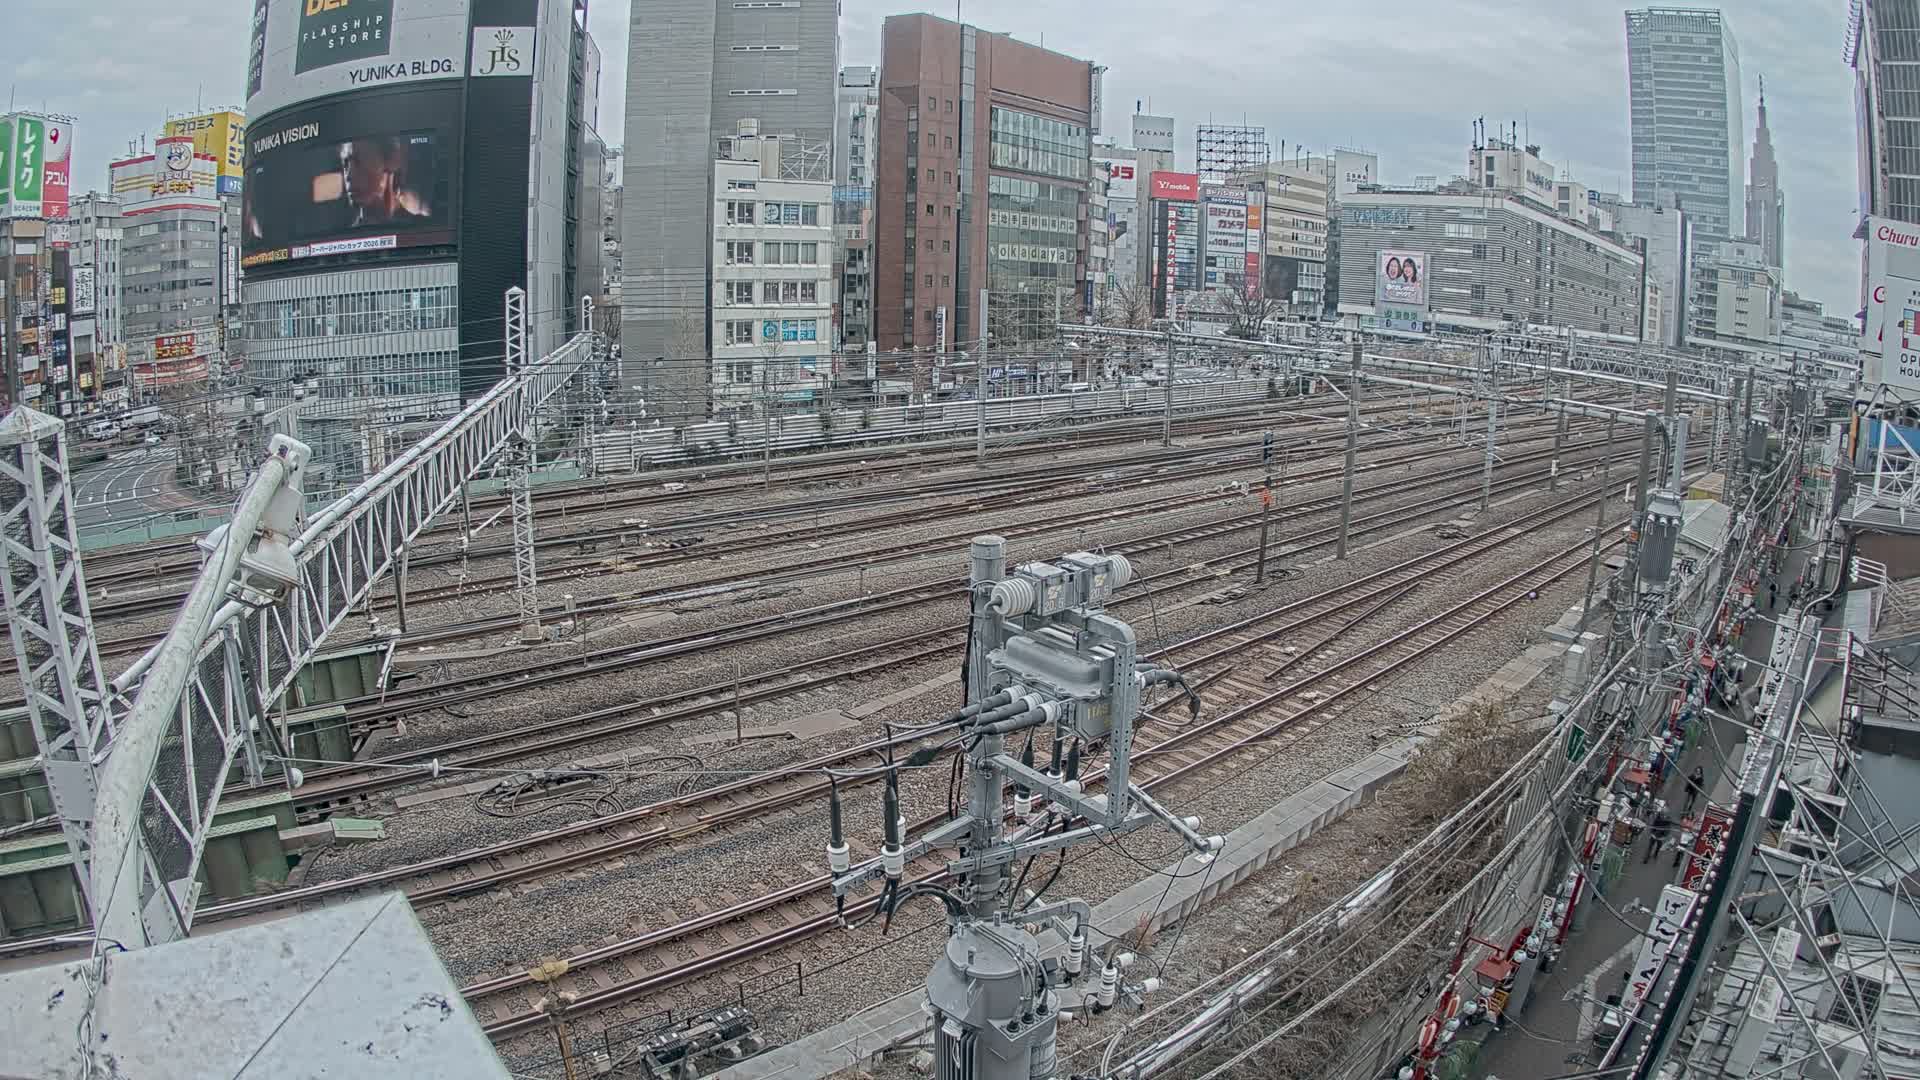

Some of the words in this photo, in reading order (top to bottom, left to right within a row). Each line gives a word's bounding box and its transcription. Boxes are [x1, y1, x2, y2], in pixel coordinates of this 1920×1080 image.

[303, 15, 383, 43] FLAGSHIP
[328, 29, 382, 49] STORE
[349, 63, 408, 84] YUNIKA
[411, 58, 456, 76] BLDG.
[175, 117, 215, 134] プロミス
[253, 132, 281, 155] YUNIKA
[282, 122, 319, 145] VISION
[21, 122, 37, 190] レイク
[44, 170, 68, 186] アコム
[1878, 225, 1919, 247] Churu
[1000, 246, 1065, 261] okadaya
[1900, 352, 1920, 368] OP
